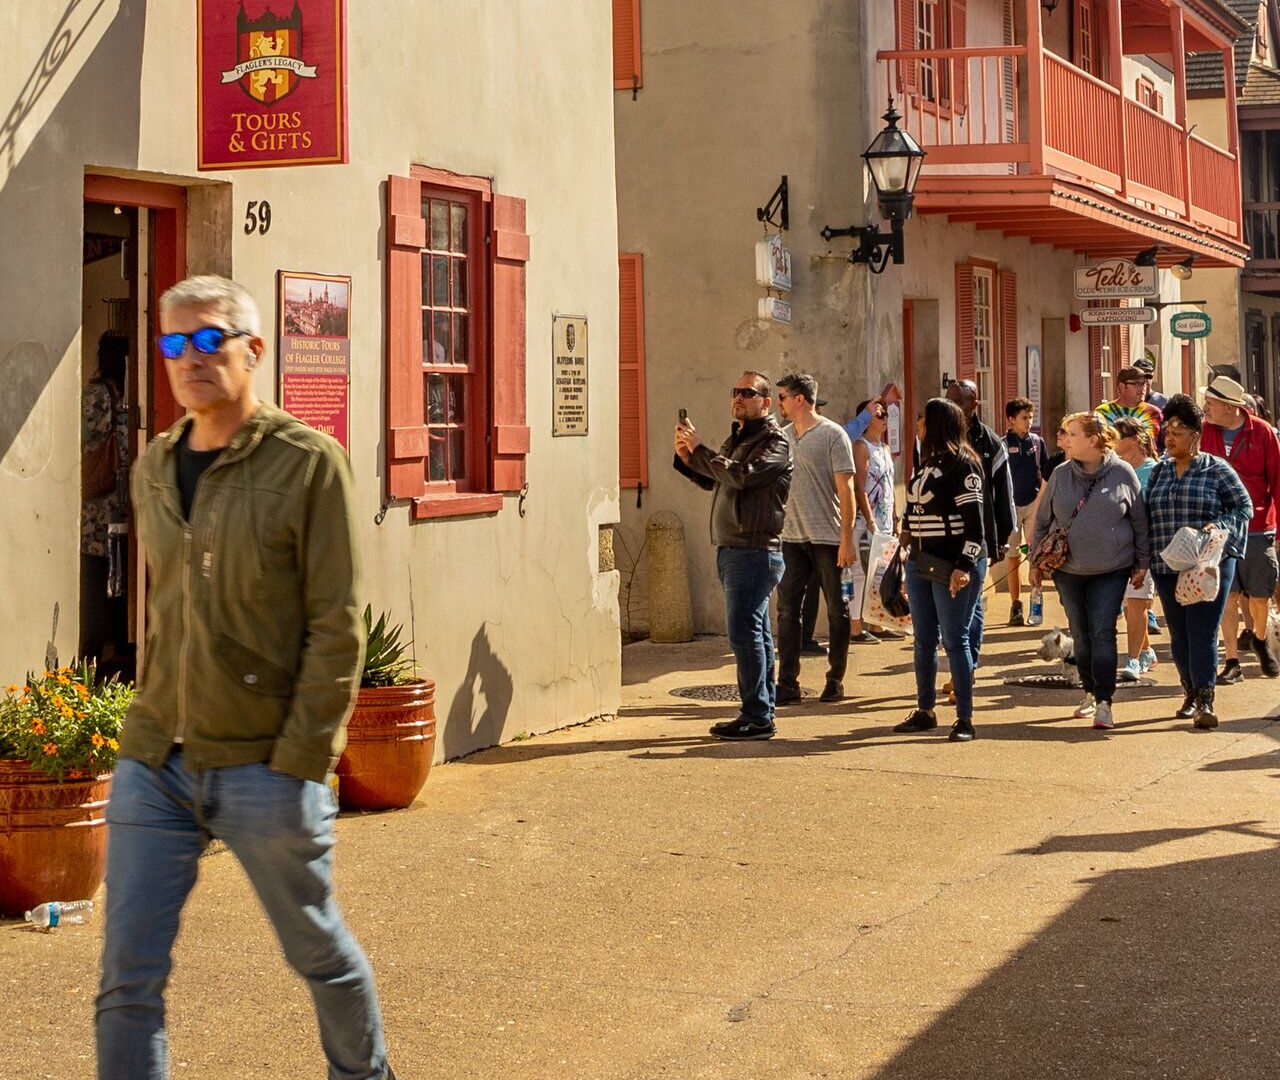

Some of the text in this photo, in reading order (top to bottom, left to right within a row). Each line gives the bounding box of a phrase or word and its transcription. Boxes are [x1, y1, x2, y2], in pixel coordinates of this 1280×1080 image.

[235, 58, 303, 74] FLAGLER'S LEGACY
[231, 111, 301, 132] TOURS
[228, 130, 312, 153] & GIFTS
[243, 199, 271, 235] 59
[1085, 262, 1144, 291] Tedi's
[291, 339, 341, 351] HISTORIC TOURS
[285, 353, 346, 365] OF FLAGLER COLLEGE
[318, 424, 335, 435] DAILY
